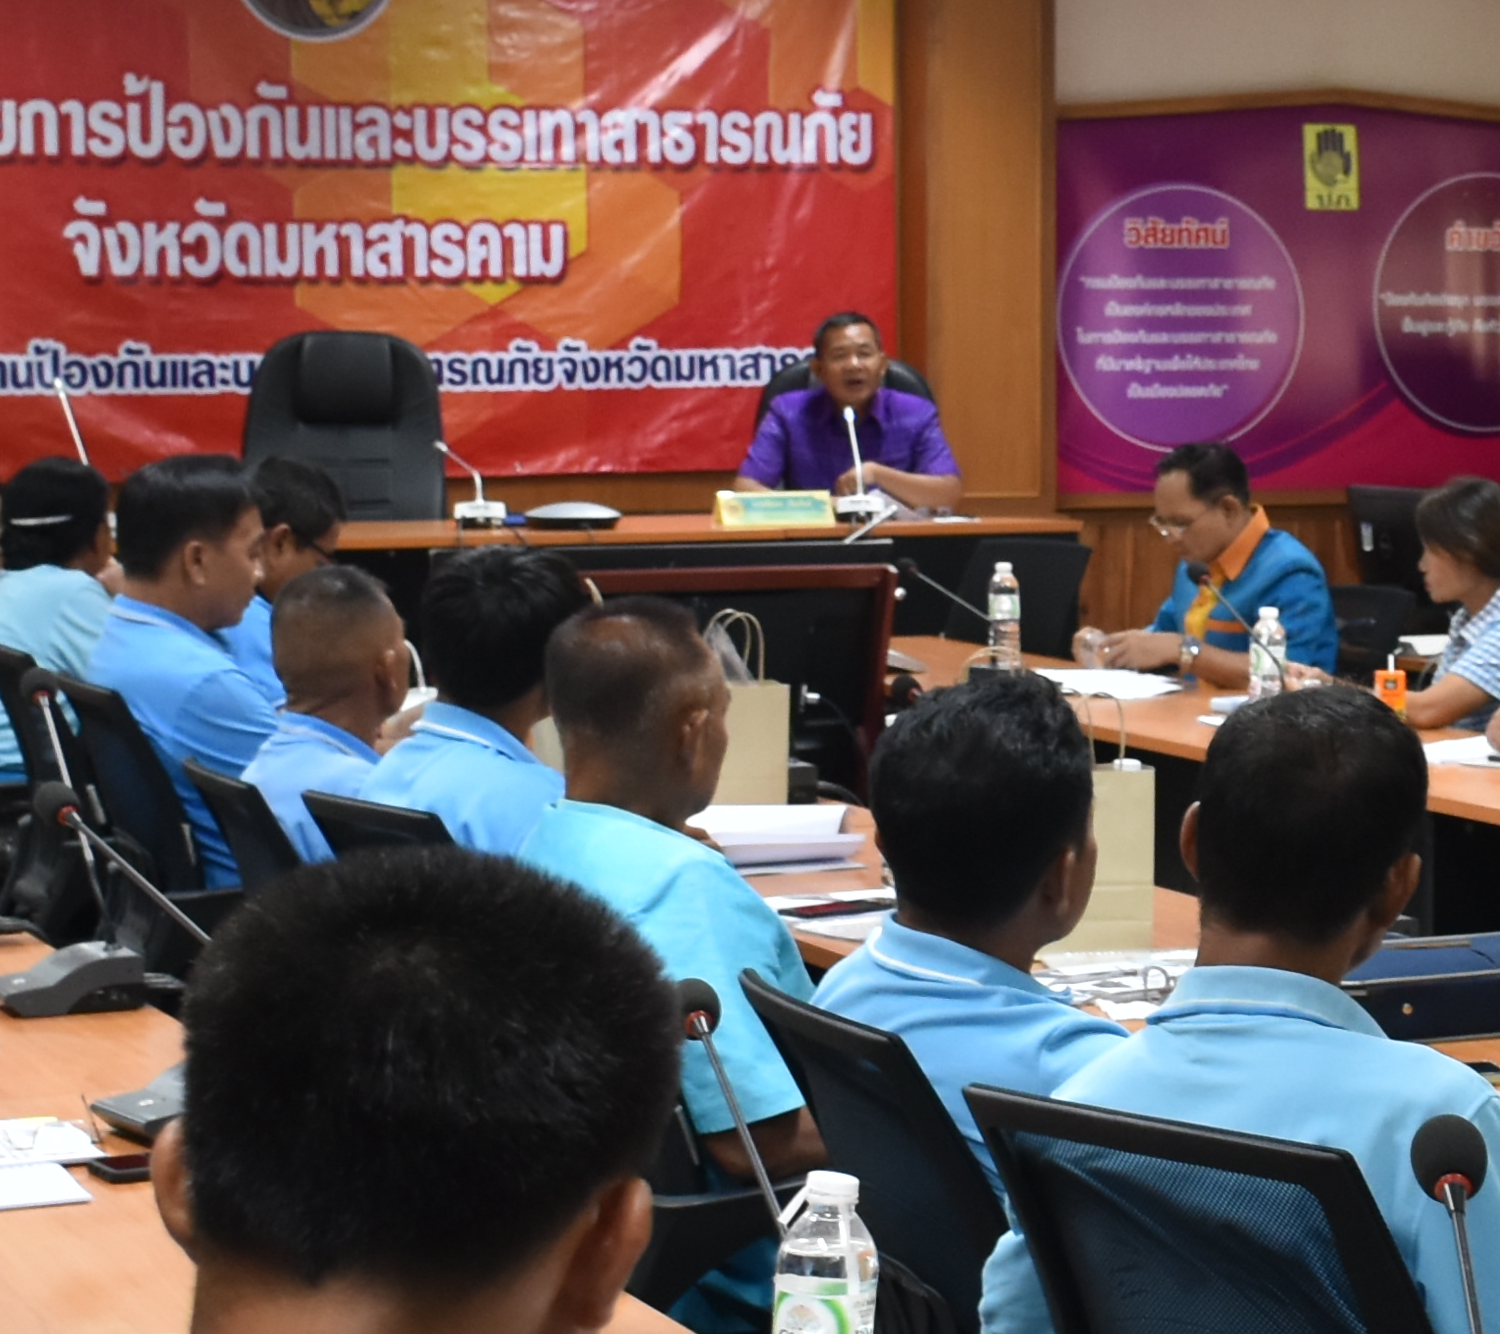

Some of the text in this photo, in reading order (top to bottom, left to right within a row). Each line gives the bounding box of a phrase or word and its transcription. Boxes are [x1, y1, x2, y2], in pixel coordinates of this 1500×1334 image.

[62, 195, 566, 279] จังหวัดมหาสารคาม
